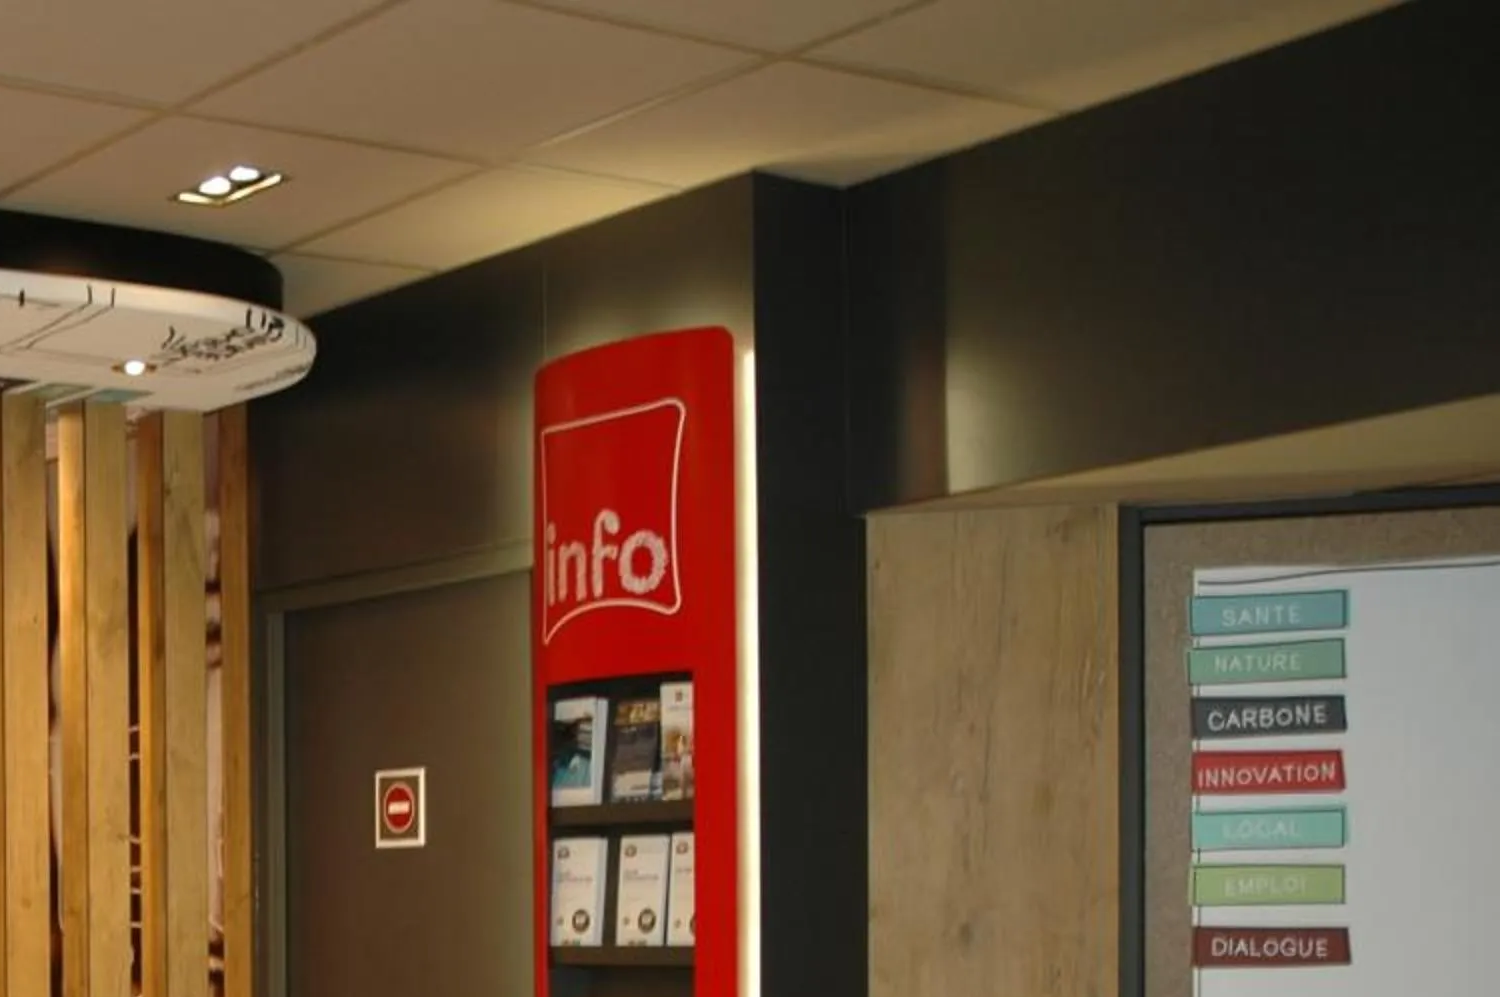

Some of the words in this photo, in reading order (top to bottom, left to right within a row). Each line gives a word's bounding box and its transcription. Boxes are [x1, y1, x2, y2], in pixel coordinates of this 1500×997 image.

[547, 508, 668, 606] info
[1213, 653, 1302, 673] NATURE
[1208, 704, 1328, 731] CARBONE
[1198, 763, 1336, 787] INNOVATION
[1221, 819, 1302, 839] LOCAL
[1223, 875, 1308, 897] EMPLOI
[1211, 937, 1329, 959] DIALOGUE
